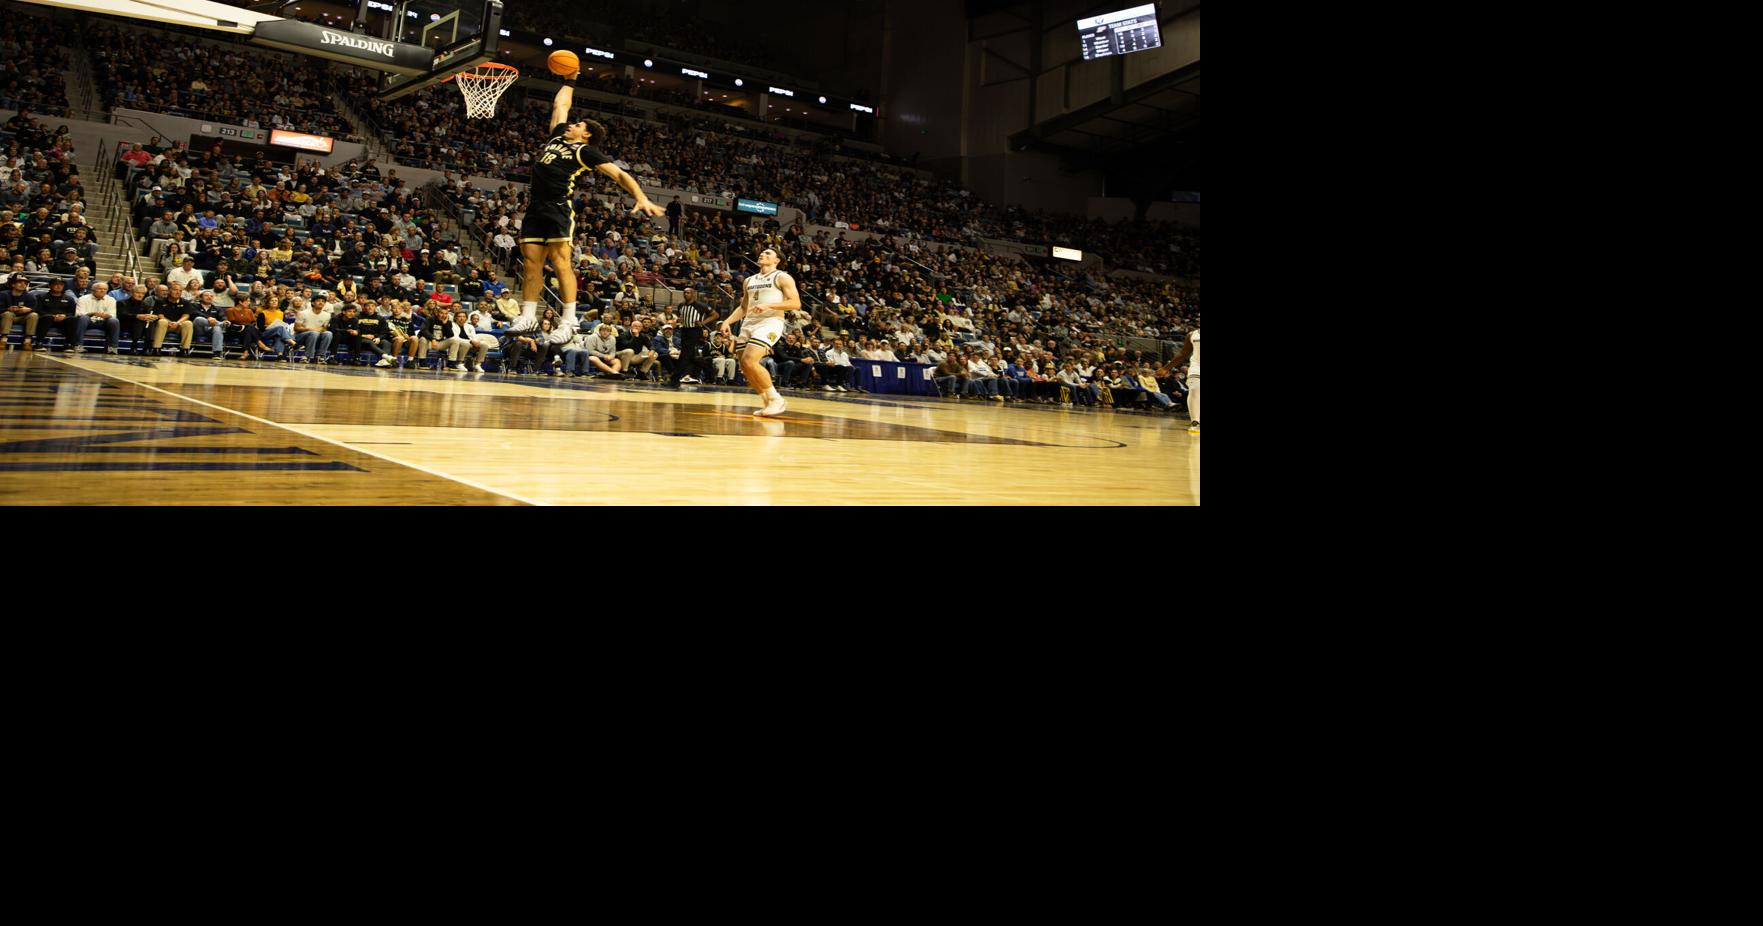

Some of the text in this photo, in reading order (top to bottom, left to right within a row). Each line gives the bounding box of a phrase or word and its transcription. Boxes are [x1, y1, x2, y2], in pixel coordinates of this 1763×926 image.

[367, 1, 393, 11] EPSI
[320, 31, 395, 57] SPALDING
[586, 48, 614, 58] PEPSI
[682, 68, 708, 78] PEPSI
[769, 87, 794, 96] PEPSI
[850, 104, 872, 113] PEPSI
[540, 152, 557, 164] 18
